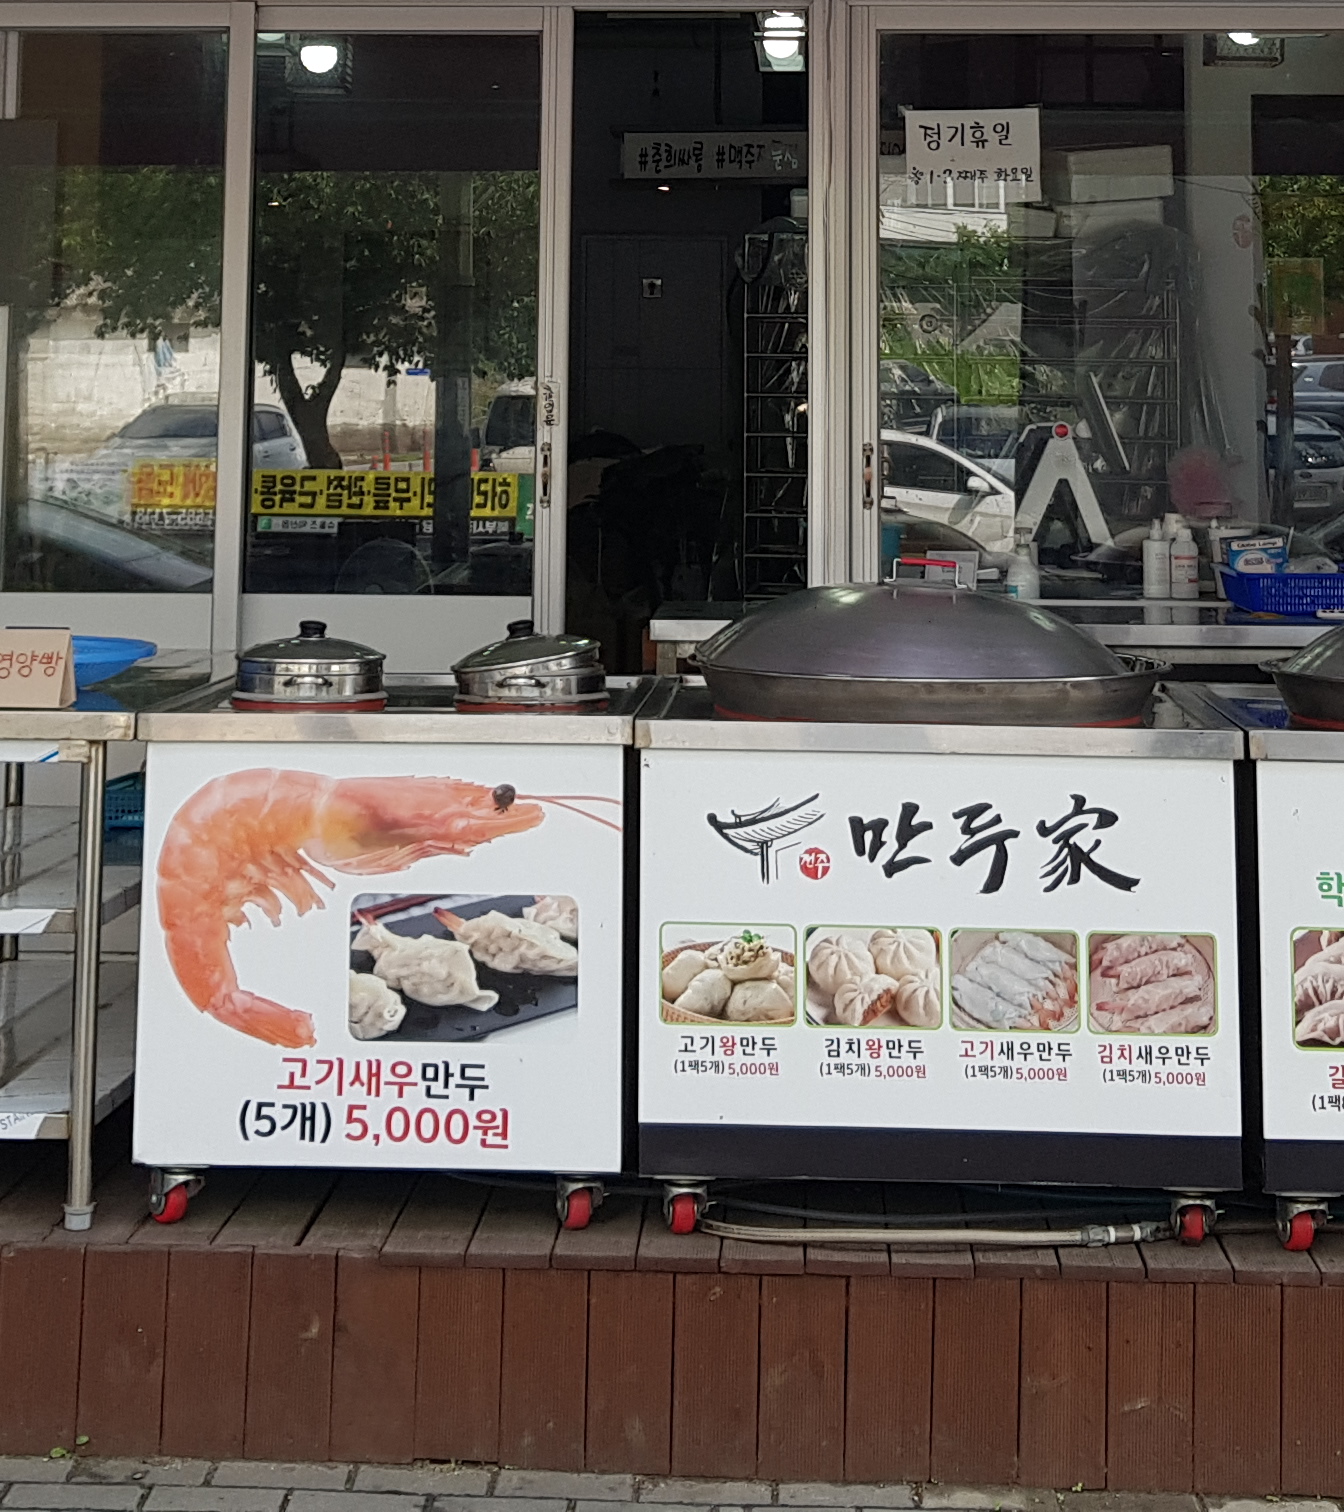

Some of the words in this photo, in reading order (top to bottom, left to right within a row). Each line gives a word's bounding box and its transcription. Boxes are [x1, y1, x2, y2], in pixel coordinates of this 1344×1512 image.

[919, 121, 1012, 151] 정기휴일
[679, 1036, 777, 1057] 고기왕만두
[825, 1038, 924, 1060] 김치왕만두
[959, 1040, 1072, 1062] 고기새우만두
[1098, 1044, 1210, 1070] 김치새우만두
[674, 1060, 724, 1074] (1팩5개)
[728, 1062, 779, 1076] 5,000원
[820, 1063, 870, 1077] (1팩5개)
[875, 1065, 926, 1079] 5,000원
[965, 1065, 1017, 1079] (1팩5개)
[1012, 1067, 1067, 1081] 5,000원
[1103, 1069, 1151, 1084] (1팩5개)
[1155, 1072, 1205, 1086] 5,000원
[273, 1058, 489, 1104] 고기새우만두
[240, 1100, 331, 1143] (5개)
[345, 1104, 508, 1149] 5,000원
